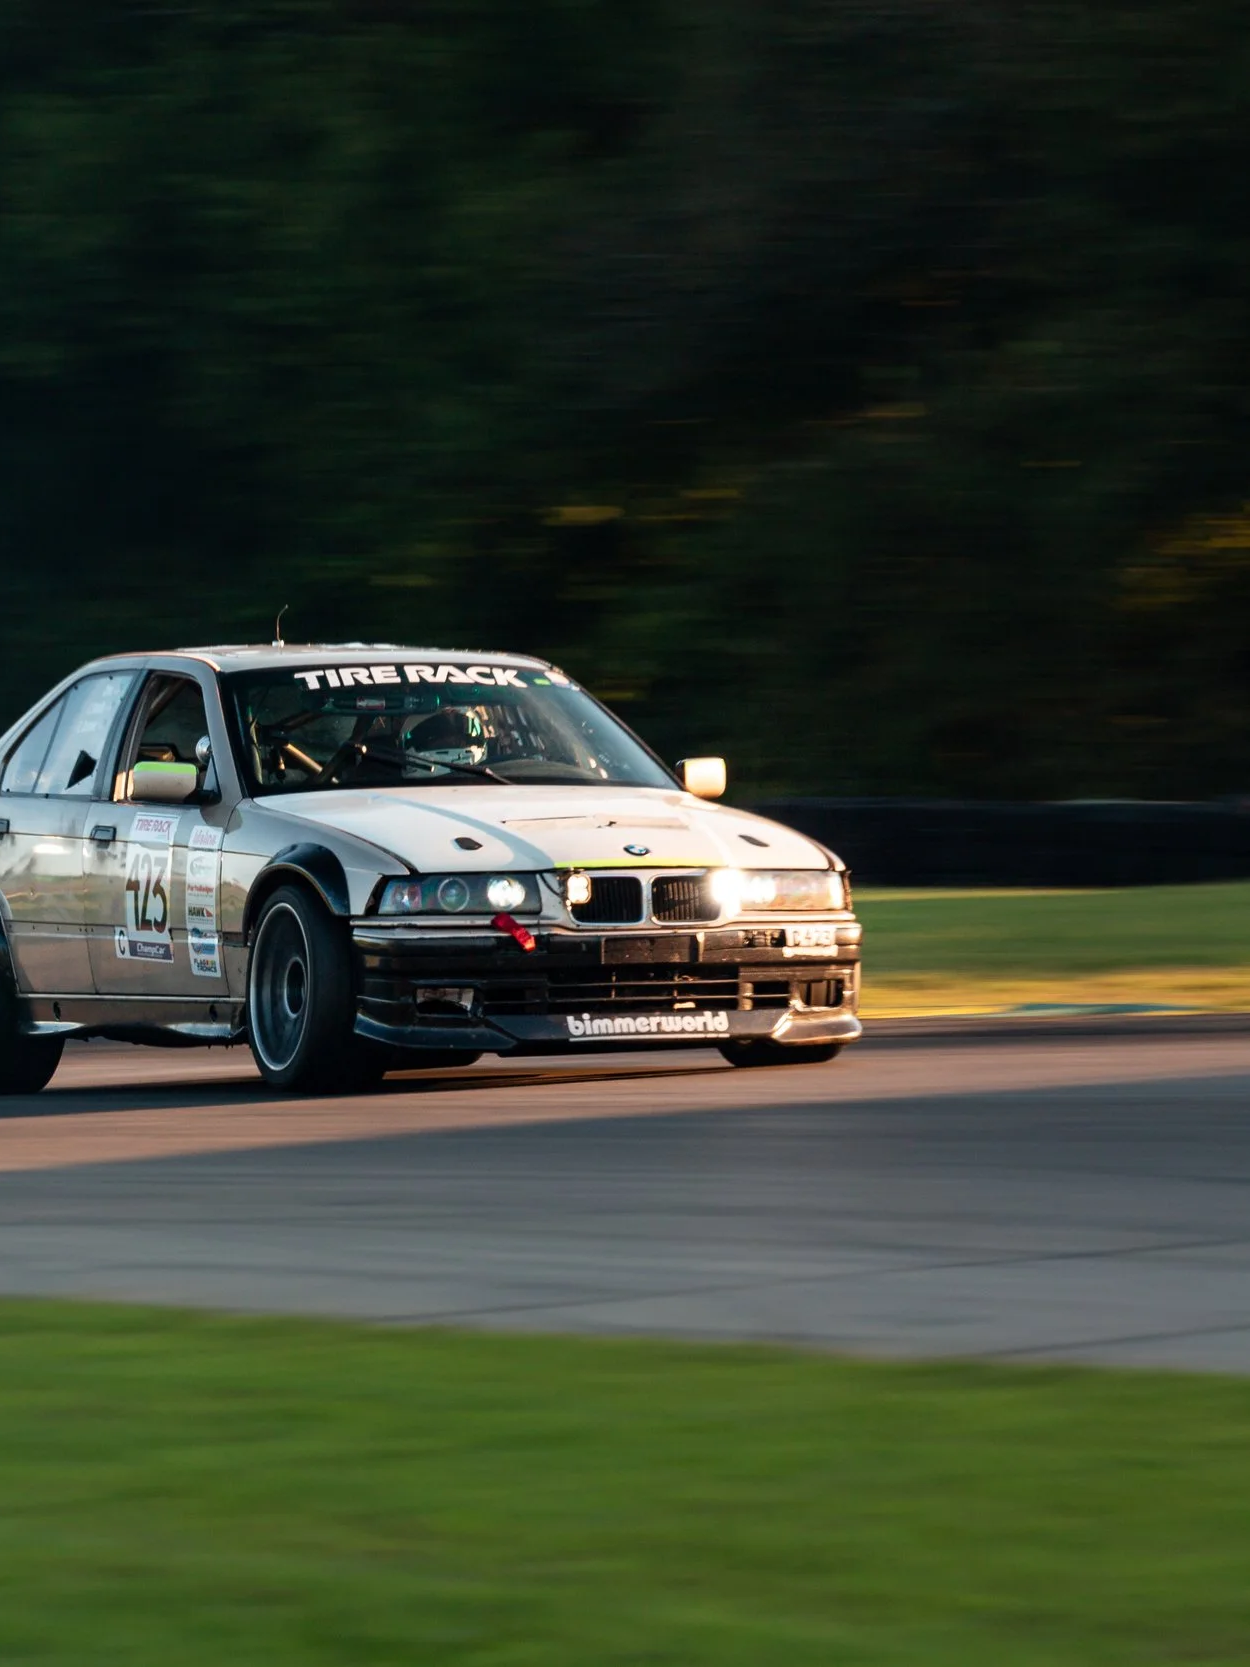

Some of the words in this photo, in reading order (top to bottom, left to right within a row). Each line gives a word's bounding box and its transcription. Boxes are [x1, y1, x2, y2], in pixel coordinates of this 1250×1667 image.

[294, 665, 401, 691] TIRE
[403, 665, 528, 688] RACK
[136, 819, 152, 831] TIRE
[126, 853, 169, 933] 423
[188, 906, 205, 917] HAWK
[118, 929, 126, 955] C
[136, 943, 166, 955] ChampCar
[566, 1011, 729, 1036] bimmerworld
